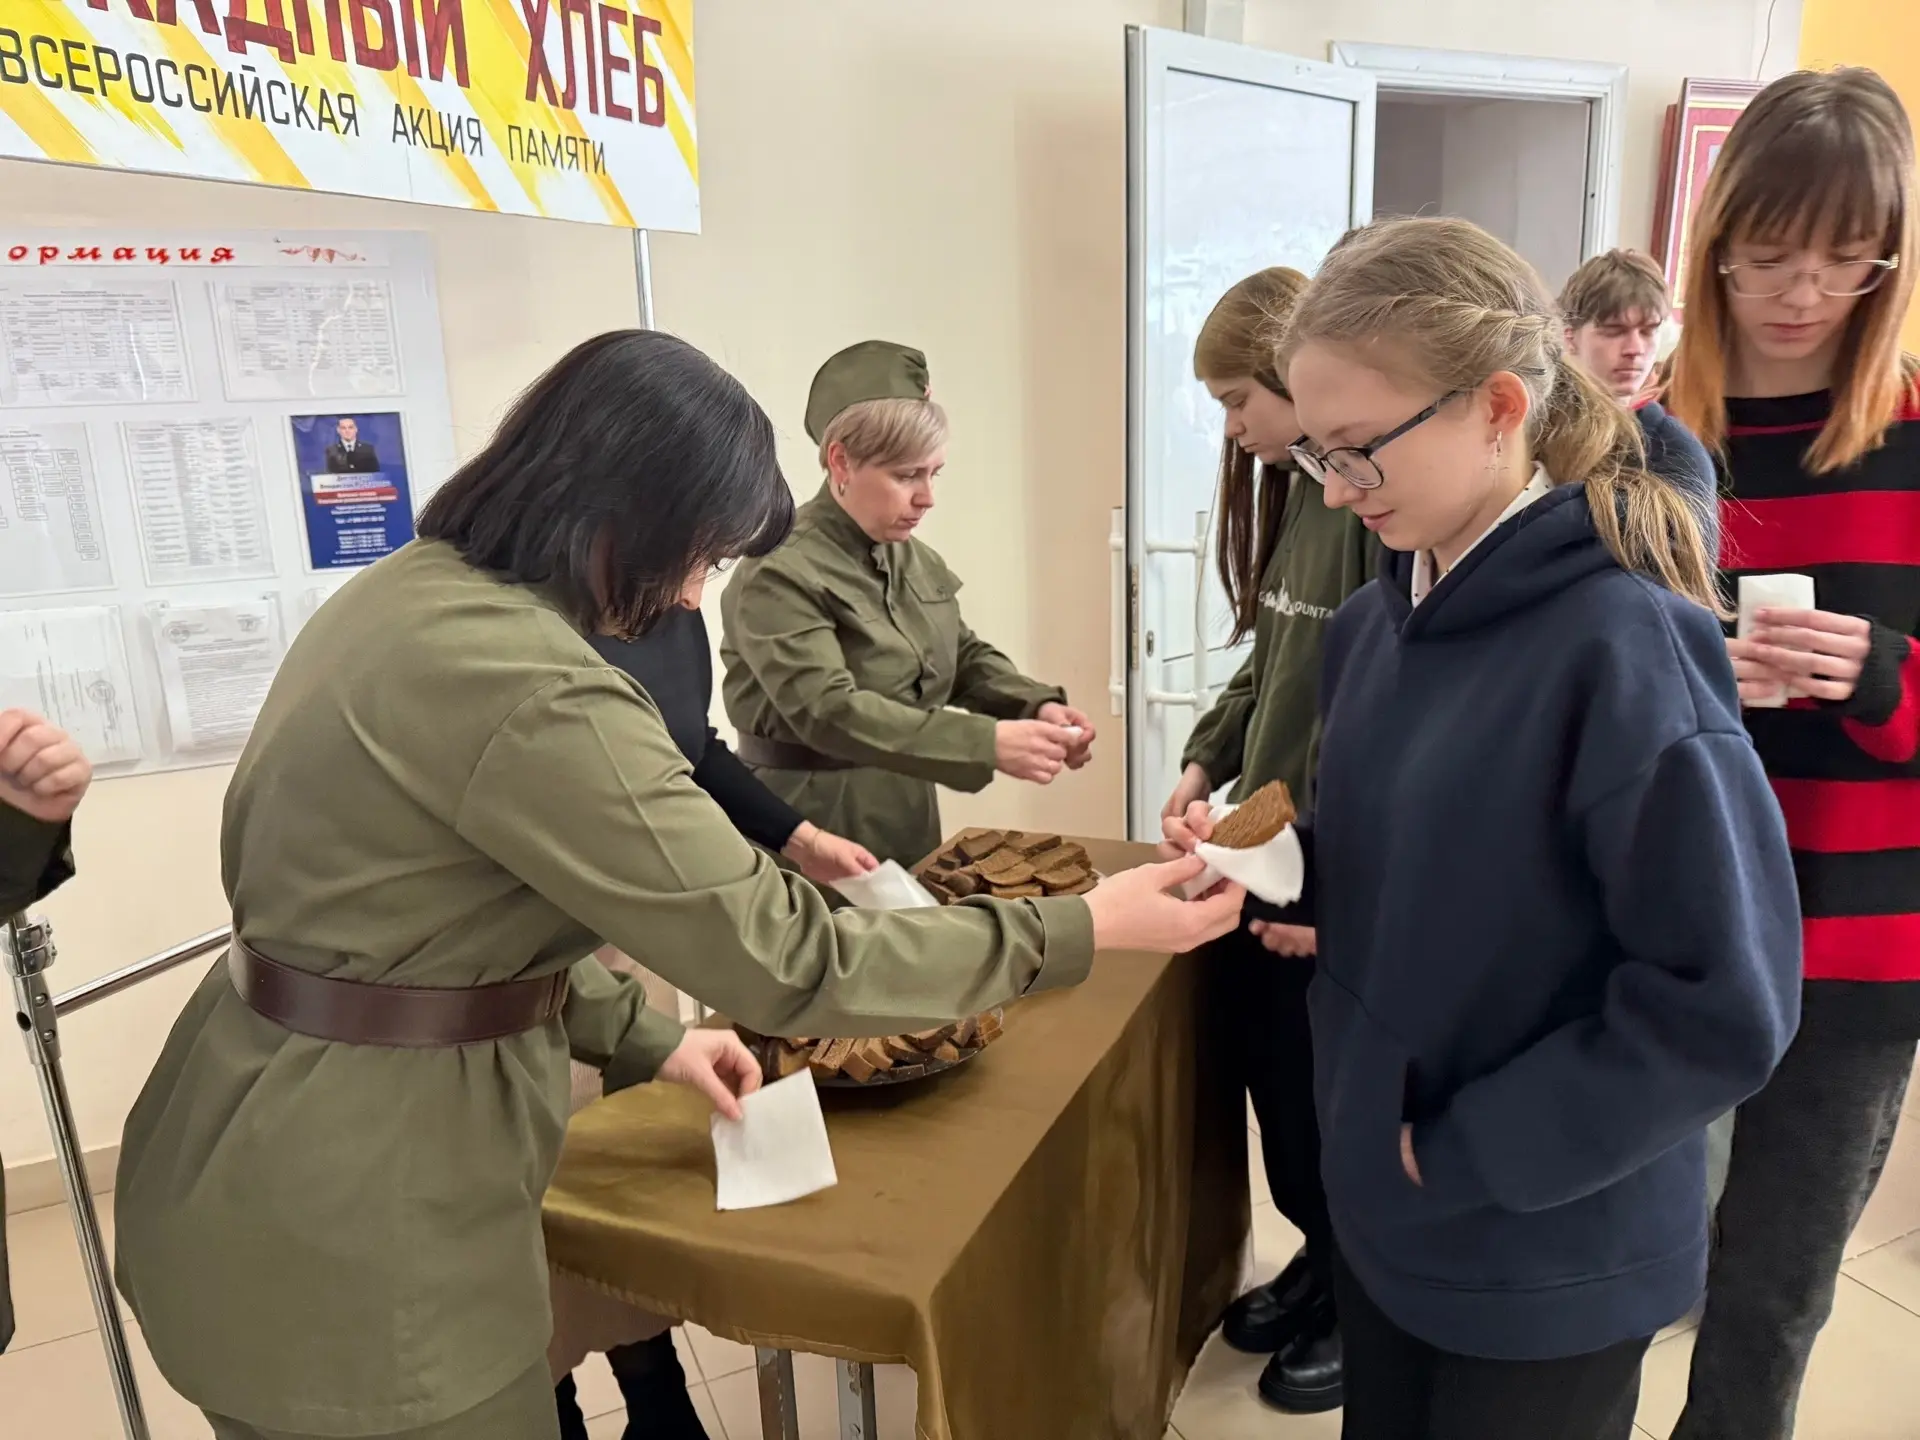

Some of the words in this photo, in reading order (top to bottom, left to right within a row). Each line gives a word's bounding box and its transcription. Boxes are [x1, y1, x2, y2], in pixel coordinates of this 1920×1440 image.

[0, 27, 360, 137] ВСЕРОССИЙСКАЯ
[392, 103, 484, 157] АКЦИЯ
[508, 124, 606, 176] ПАМЯТИ
[525, 0, 666, 128] ХЛЕБ
[7, 245, 235, 265] ормация
